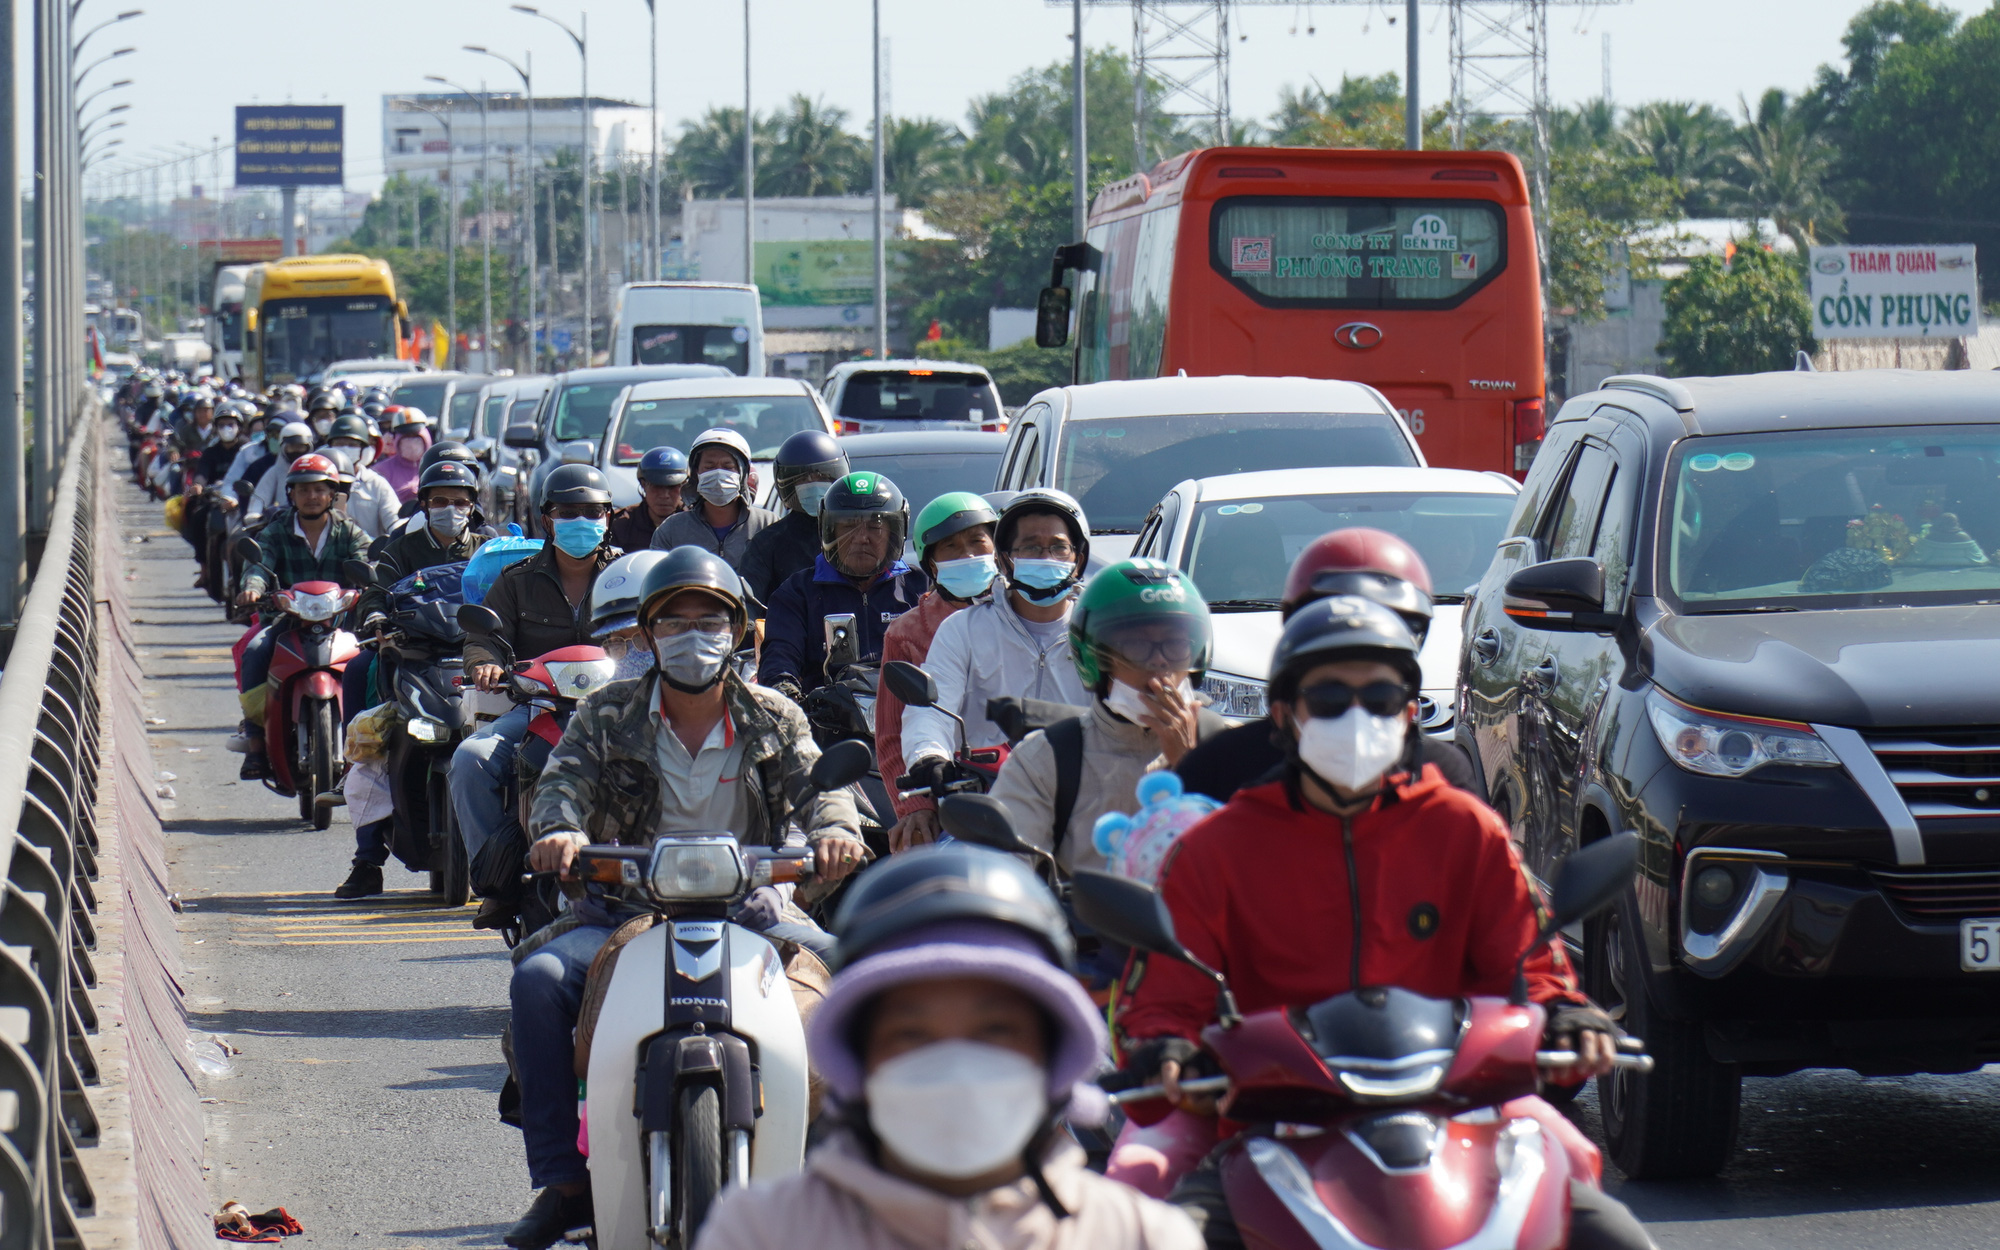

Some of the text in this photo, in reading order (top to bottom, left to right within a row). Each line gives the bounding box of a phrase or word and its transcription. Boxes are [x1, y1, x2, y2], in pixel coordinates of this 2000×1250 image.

[1419, 219, 1441, 234] 10
[1312, 231, 1393, 250] CÔNG TY
[1432, 238, 1455, 249] TRE
[1368, 256, 1440, 278] TRANG
[1849, 251, 1891, 274] THAM
[1896, 250, 1937, 275] QUAN
[1818, 277, 1971, 336] CỒN PHỤNG
[1469, 380, 1516, 391] TOWN
[679, 925, 716, 933] HONDA
[670, 997, 729, 1009] HONDA
